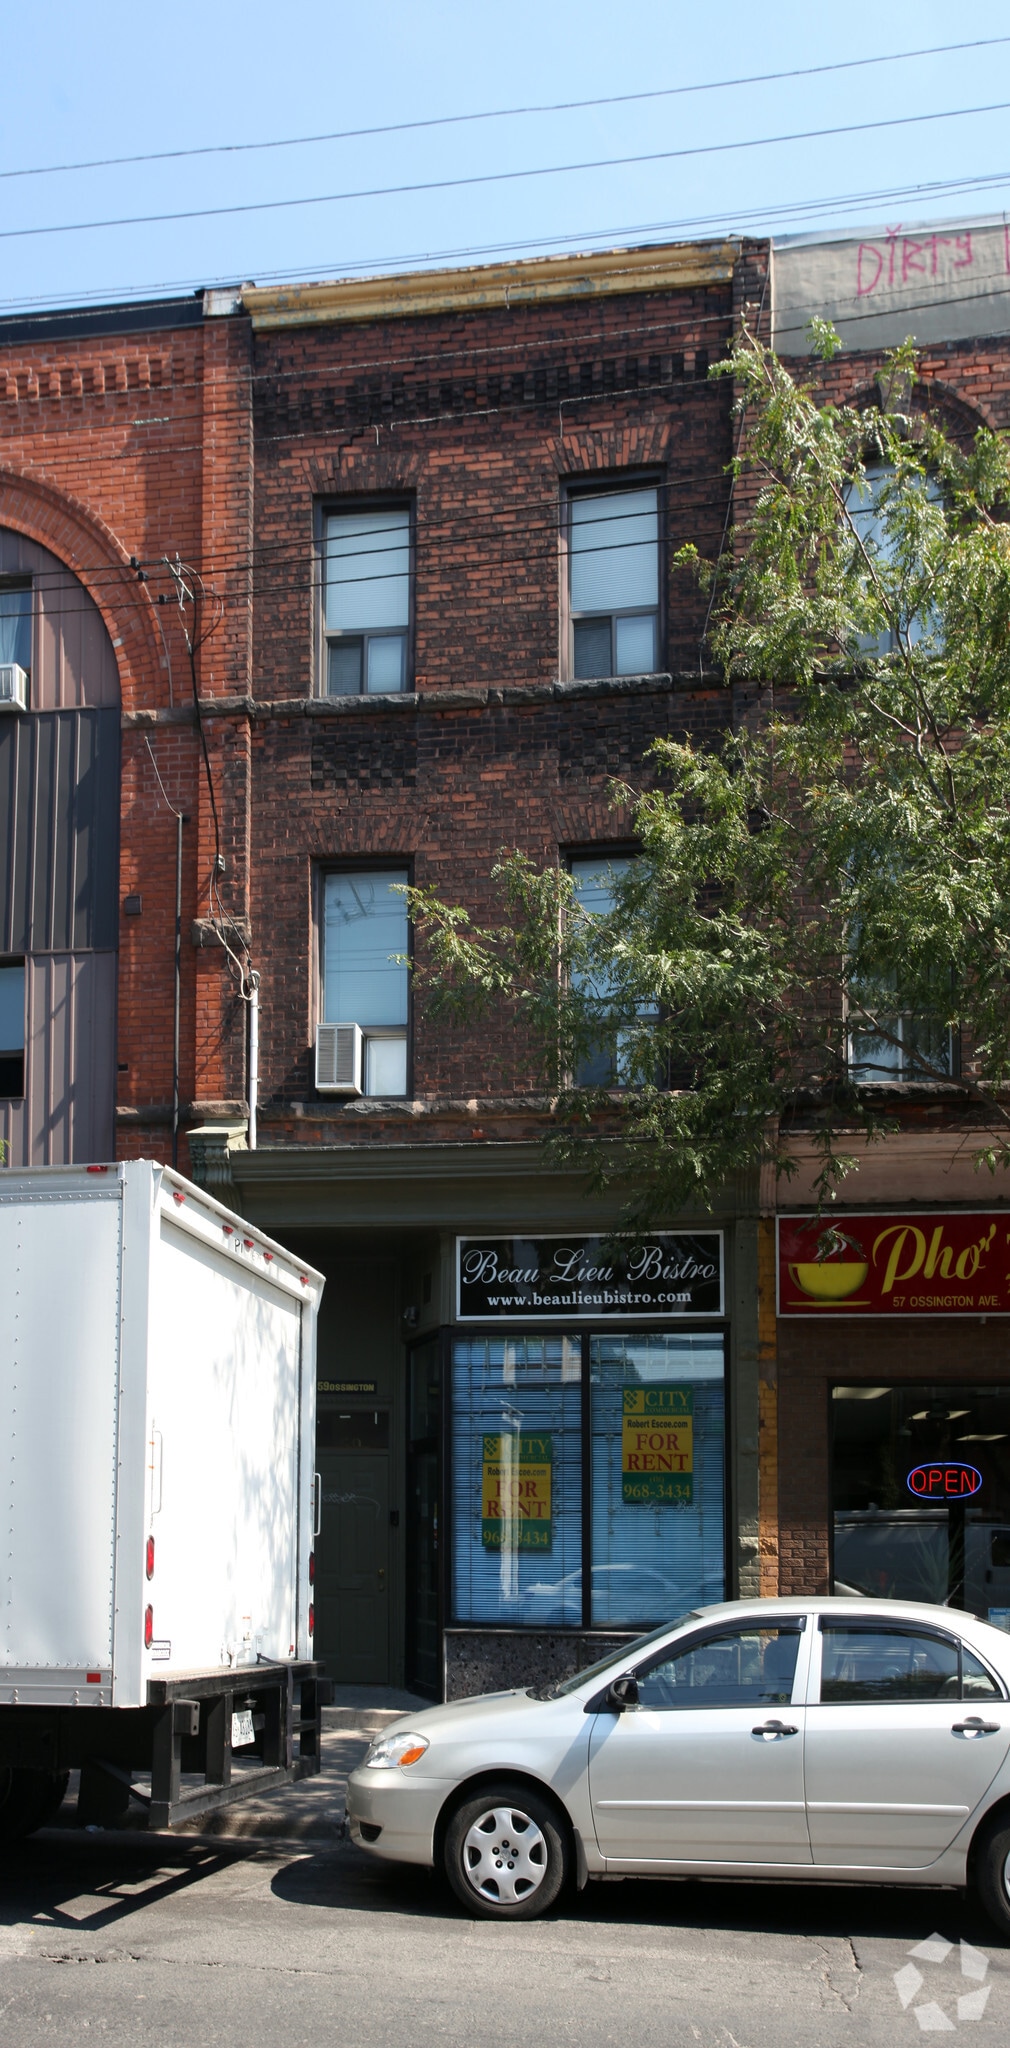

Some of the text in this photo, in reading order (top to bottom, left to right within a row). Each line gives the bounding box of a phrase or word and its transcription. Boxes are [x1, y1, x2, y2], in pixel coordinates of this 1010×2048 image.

[463, 1246, 717, 1284] Beau Lieu Bistro
[487, 1290, 692, 1306] www.beaulieubistro.com
[893, 1295, 1001, 1307] 57 OSSINGTON AVE.
[645, 1391, 690, 1406] CITY
[627, 1419, 688, 1429] Robert Escoe.com
[636, 1433, 680, 1451] FOR
[627, 1453, 689, 1471] RENT
[496, 1480, 538, 1498] FOR
[911, 1470, 976, 1493] OPEN
[624, 1484, 691, 1498] 968-3434
